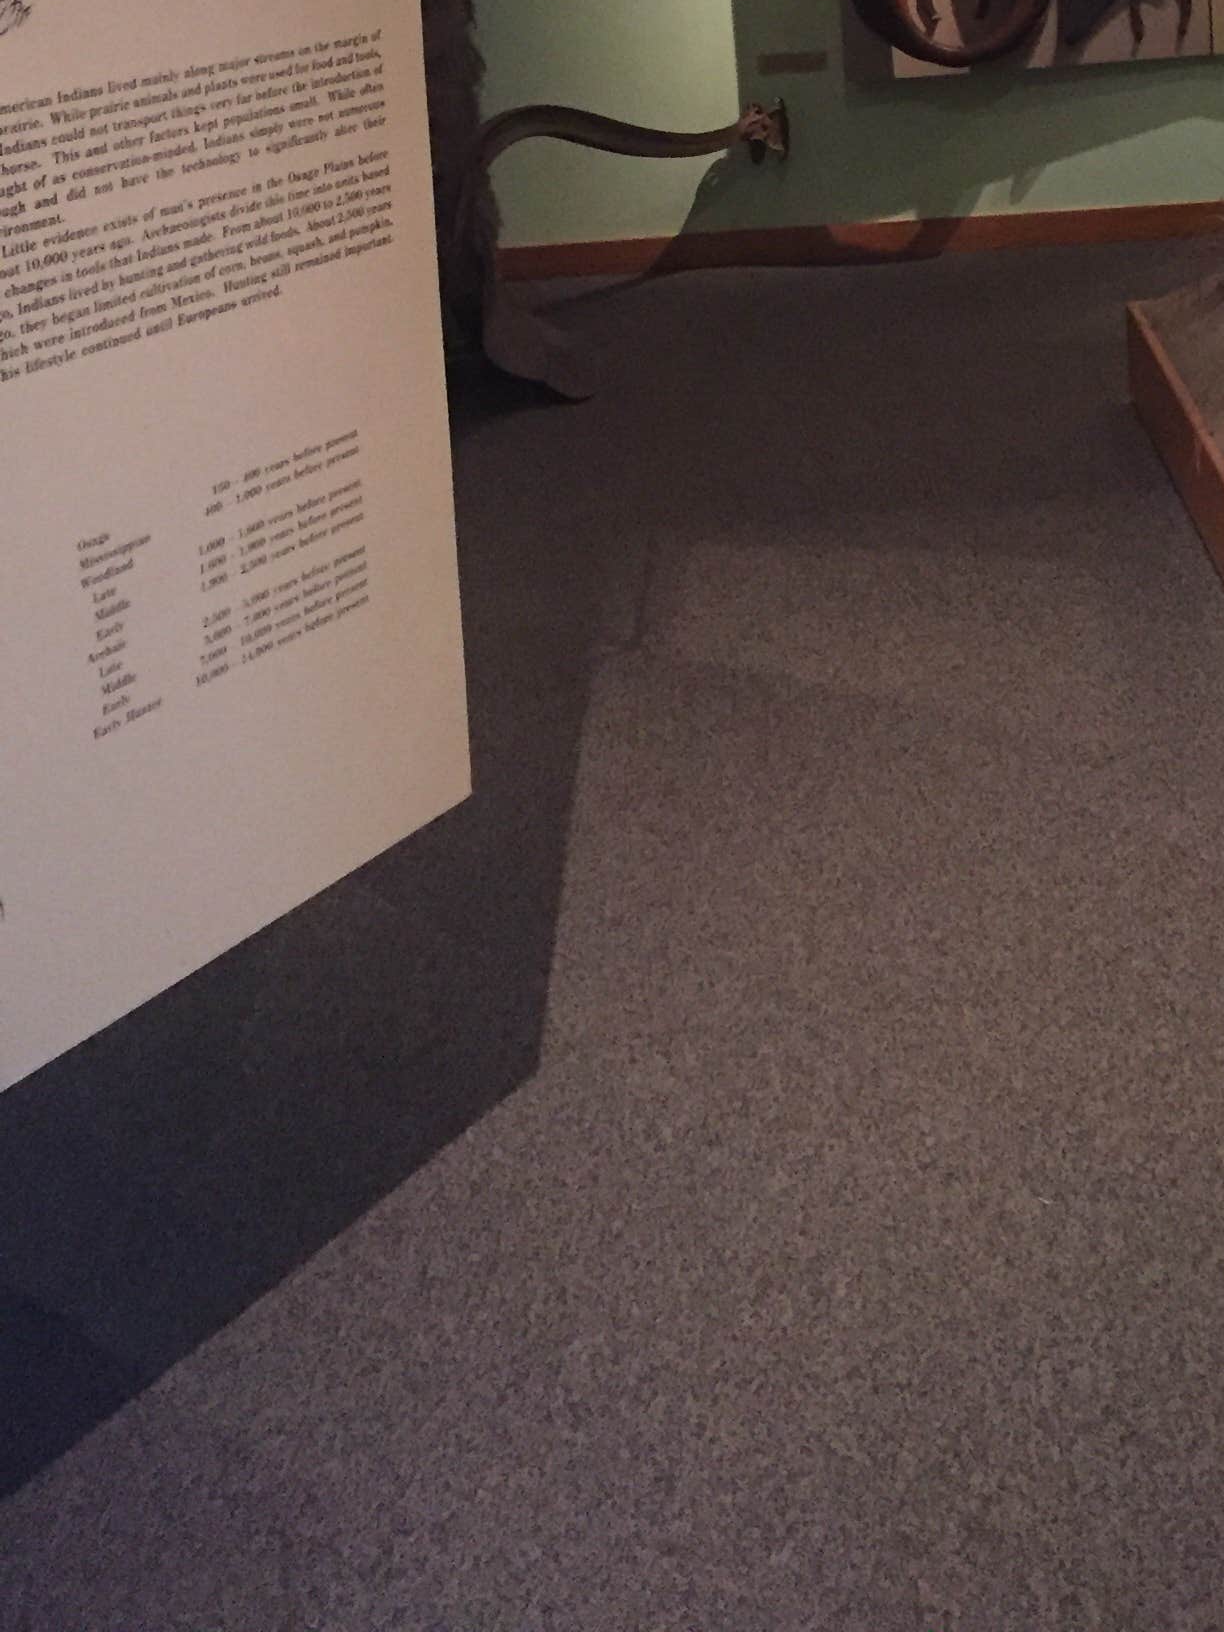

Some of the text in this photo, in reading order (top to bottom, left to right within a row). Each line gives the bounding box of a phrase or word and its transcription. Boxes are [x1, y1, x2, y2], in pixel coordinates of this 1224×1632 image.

[50, 107, 86, 126] While
[89, 99, 129, 121] prairie
[133, 88, 178, 108] animals
[181, 82, 201, 98] and
[204, 76, 238, 96] plants
[240, 72, 266, 86] were
[268, 63, 292, 80] used
[311, 55, 333, 71] food
[335, 51, 353, 66] and
[51, 125, 85, 145] could
[89, 121, 108, 137] not
[111, 108, 168, 132] transport
[210, 97, 232, 111] very
[236, 92, 251, 105] far
[255, 85, 288, 101] before
[291, 79, 307, 93] the
[311, 67, 370, 89] introduction
[373, 62, 383, 75] of
[56, 85, 103, 104] Indians
[107, 76, 137, 94] lived
[140, 69, 178, 88] mainly
[183, 64, 214, 79] along
[218, 57, 250, 72] major
[297, 45, 311, 56] on
[313, 39, 329, 53] the
[333, 33, 368, 49] margin
[370, 28, 382, 42] of
[33, 173, 46, 189] of
[52, 172, 66, 185] as
[203, 131, 244, 149] Indians
[249, 120, 283, 139] simply
[287, 115, 313, 130] were
[317, 108, 333, 123] not
[34, 115, 386, 210] and did not have the technology to significantly alter their
[52, 148, 80, 165] This
[85, 139, 108, 157] and
[112, 134, 144, 151] other
[149, 125, 189, 143] factors
[193, 116, 218, 133] kept
[222, 103, 285, 129] populations
[327, 86, 355, 103] While
[358, 81, 384, 96] often
[1, 149, 389, 259] Little evidence exists of man's presence in the Osage Plains before
[4, 274, 57, 299] changes
[61, 270, 72, 283] in
[75, 259, 105, 279] tools
[109, 251, 132, 270] that
[136, 241, 180, 262] Indians
[222, 221, 251, 238] From
[253, 210, 283, 230] about
[323, 198, 334, 211] to
[364, 183, 391, 202] years
[25, 247, 68, 272] 10,000
[71, 241, 105, 263] years
[143, 208, 226, 241] Archaeologists
[229, 198, 262, 217] divide
[264, 193, 284, 208] this
[287, 187, 310, 202] time
[361, 163, 390, 182] based
[17, 291, 65, 315] Indians
[68, 278, 99, 301] lived
[101, 276, 115, 292] by
[119, 264, 163, 286] hunting
[166, 254, 187, 272] and
[190, 241, 243, 269] gathering
[244, 231, 268, 250] wild
[307, 213, 335, 232] About
[366, 199, 392, 218] years
[20, 317, 46, 335] they
[52, 304, 91, 326] began
[94, 288, 136, 314] limited
[140, 272, 200, 300] cultivation
[204, 265, 216, 281] of
[328, 227, 346, 244] and
[33, 331, 65, 352] were
[69, 307, 135, 340] introduced
[139, 301, 167, 319] from
[223, 271, 267, 294] Hunting
[270, 261, 291, 279] still
[294, 246, 341, 272] remained
[25, 347, 76, 374] lifestyle
[80, 325, 141, 357] continued
[145, 315, 172, 337] until
[177, 299, 237, 327] Europeans
